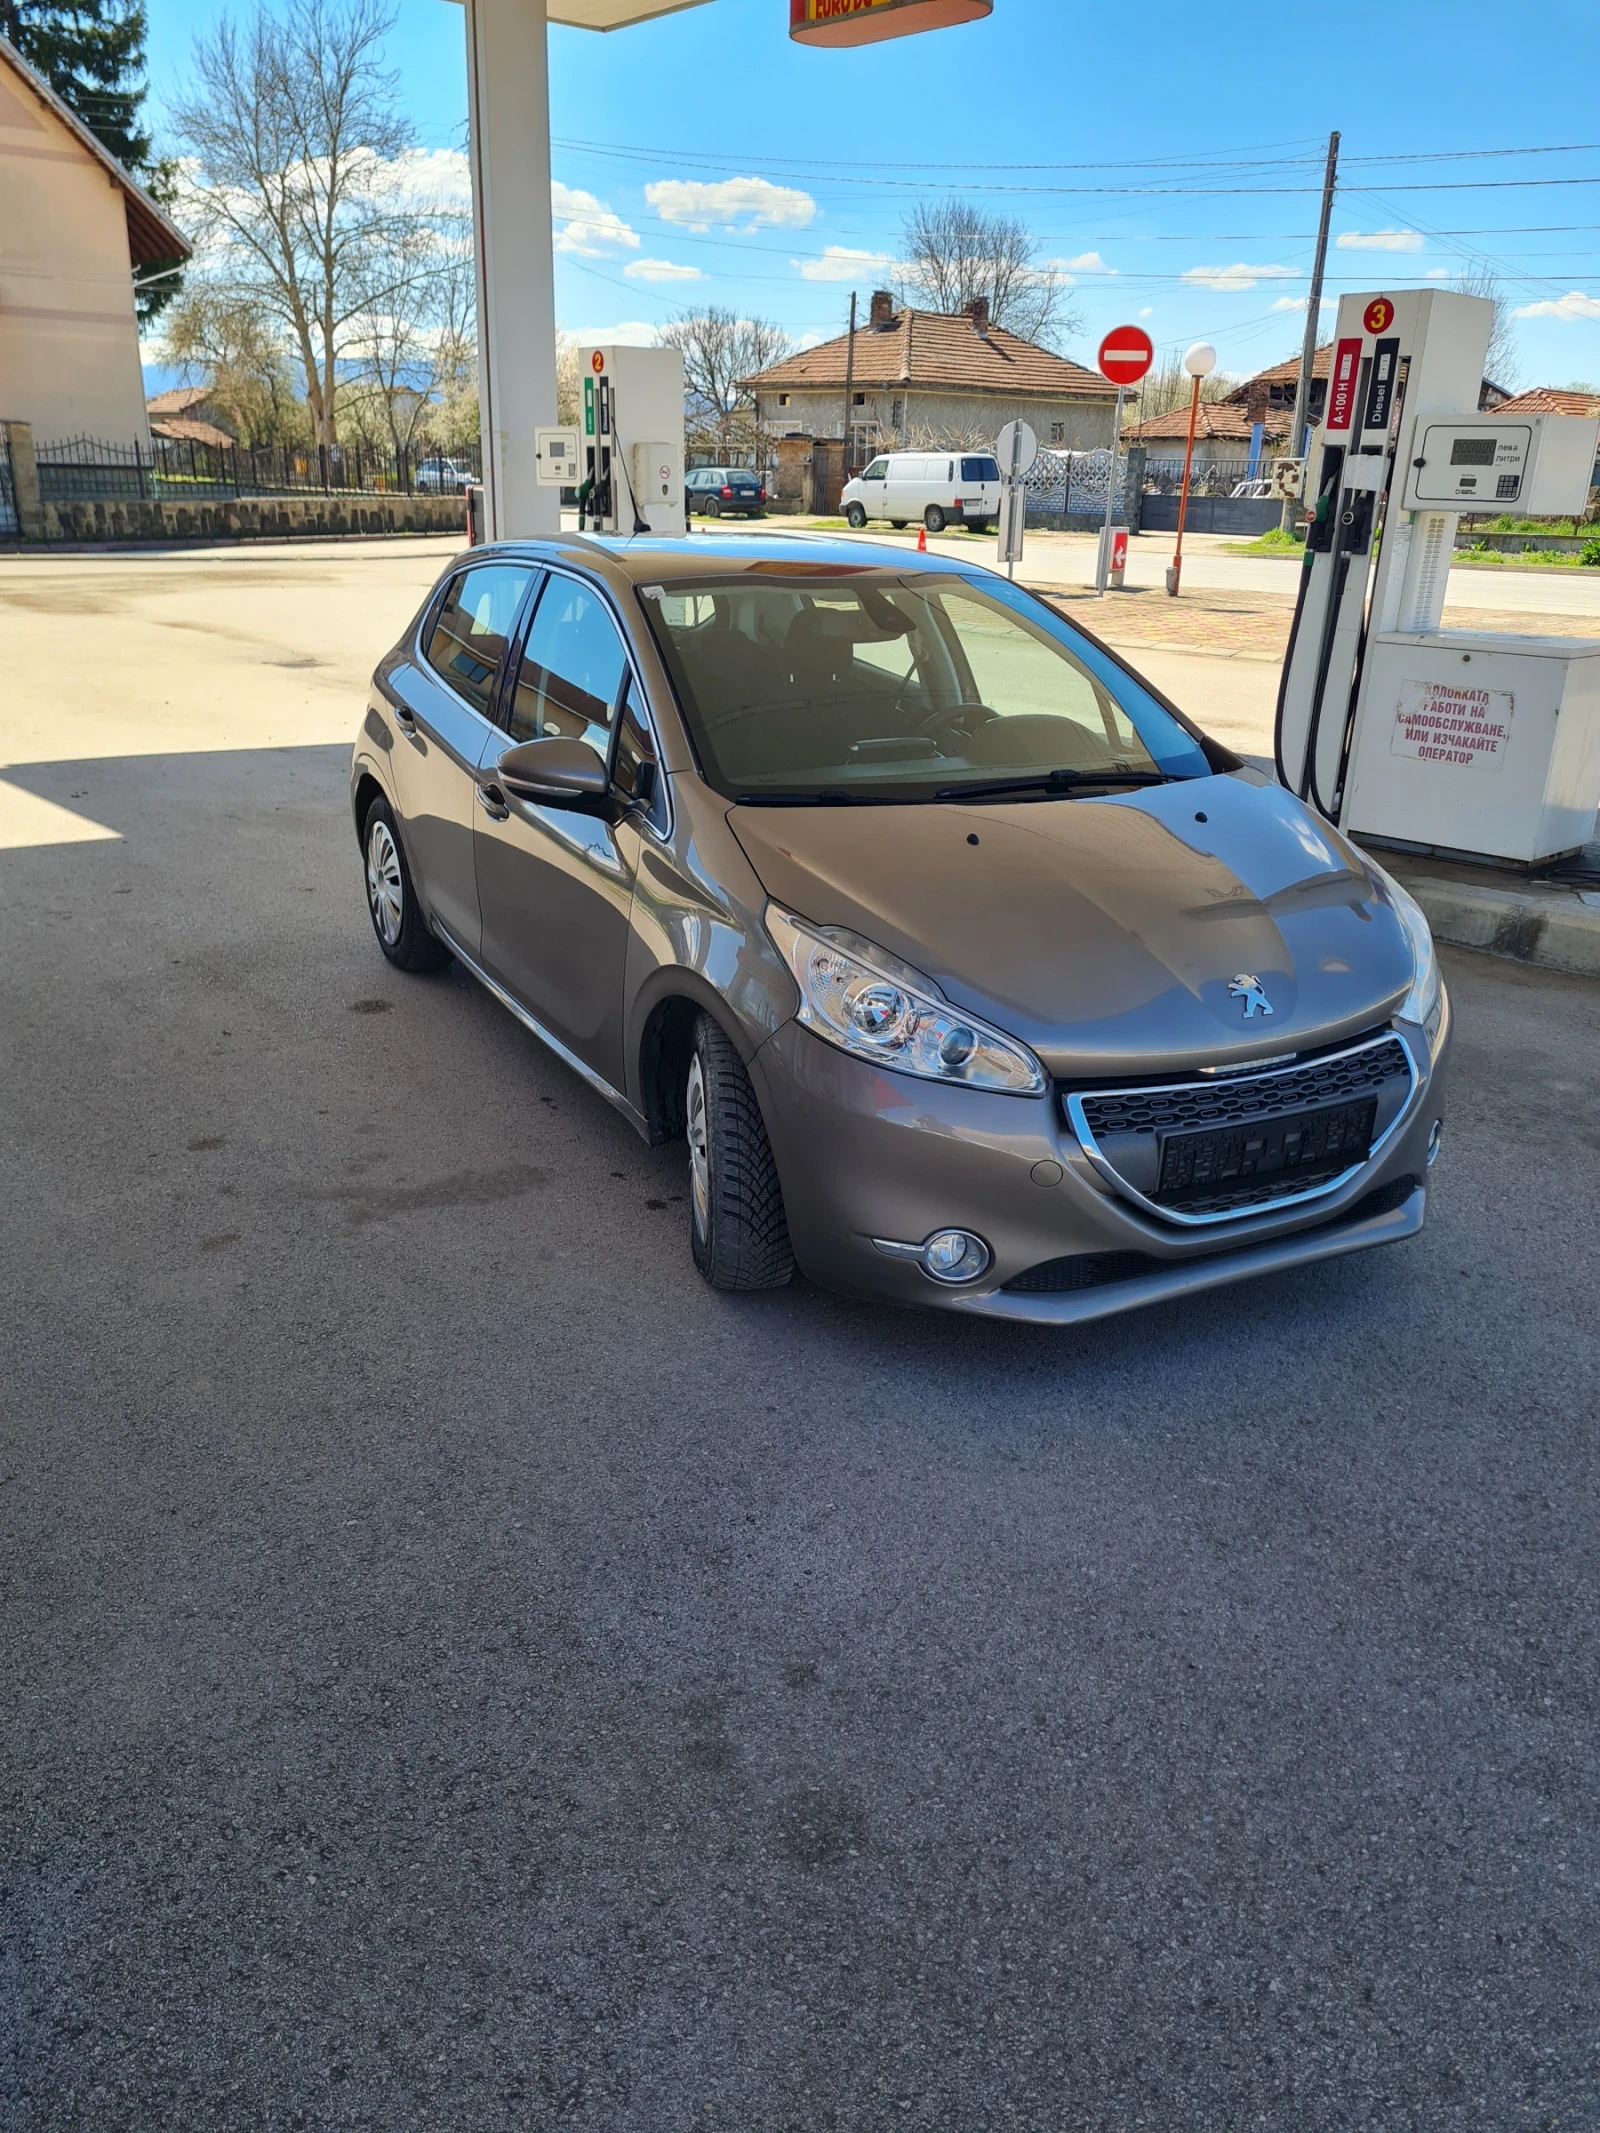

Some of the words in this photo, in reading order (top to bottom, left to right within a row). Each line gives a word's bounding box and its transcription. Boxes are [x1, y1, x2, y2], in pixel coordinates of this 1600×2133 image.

[1370, 304, 1386, 329] 3
[594, 354, 602, 370] 2
[1372, 385, 1386, 422] Diesel
[1498, 444, 1518, 452] лева
[1495, 455, 1520, 464] литри
[1469, 705, 1485, 719] НА
[1404, 728, 1429, 743] ИЛИ
[1432, 731, 1499, 753] ИЗЧАКАЙТЕ
[1417, 746, 1474, 765] ОПЕРАТОР
